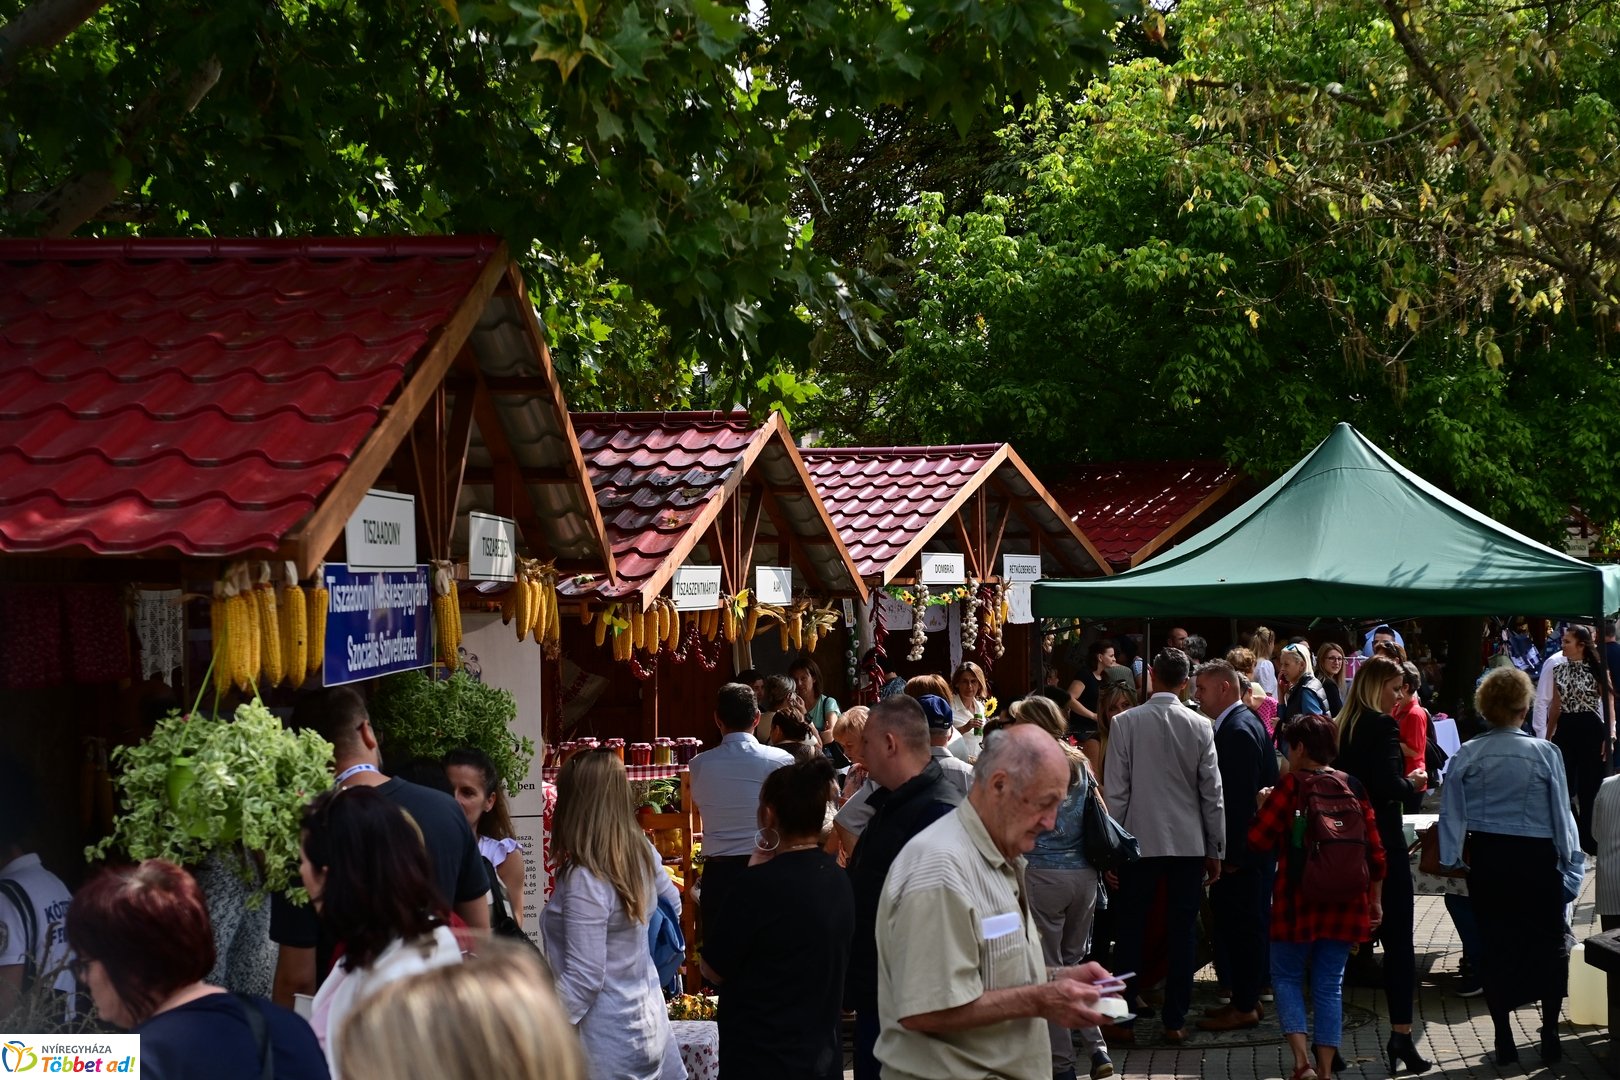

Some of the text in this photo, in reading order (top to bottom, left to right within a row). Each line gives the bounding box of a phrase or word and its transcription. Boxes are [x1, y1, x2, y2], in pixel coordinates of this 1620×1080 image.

[363, 519, 400, 545] TISZAADONY
[934, 562, 955, 574] DOMBRÁD
[326, 575, 374, 619] Tiszaadonyi
[676, 580, 718, 596] TISZASZENTMÁRTON
[347, 629, 417, 672] Szociális Szövetkezet
